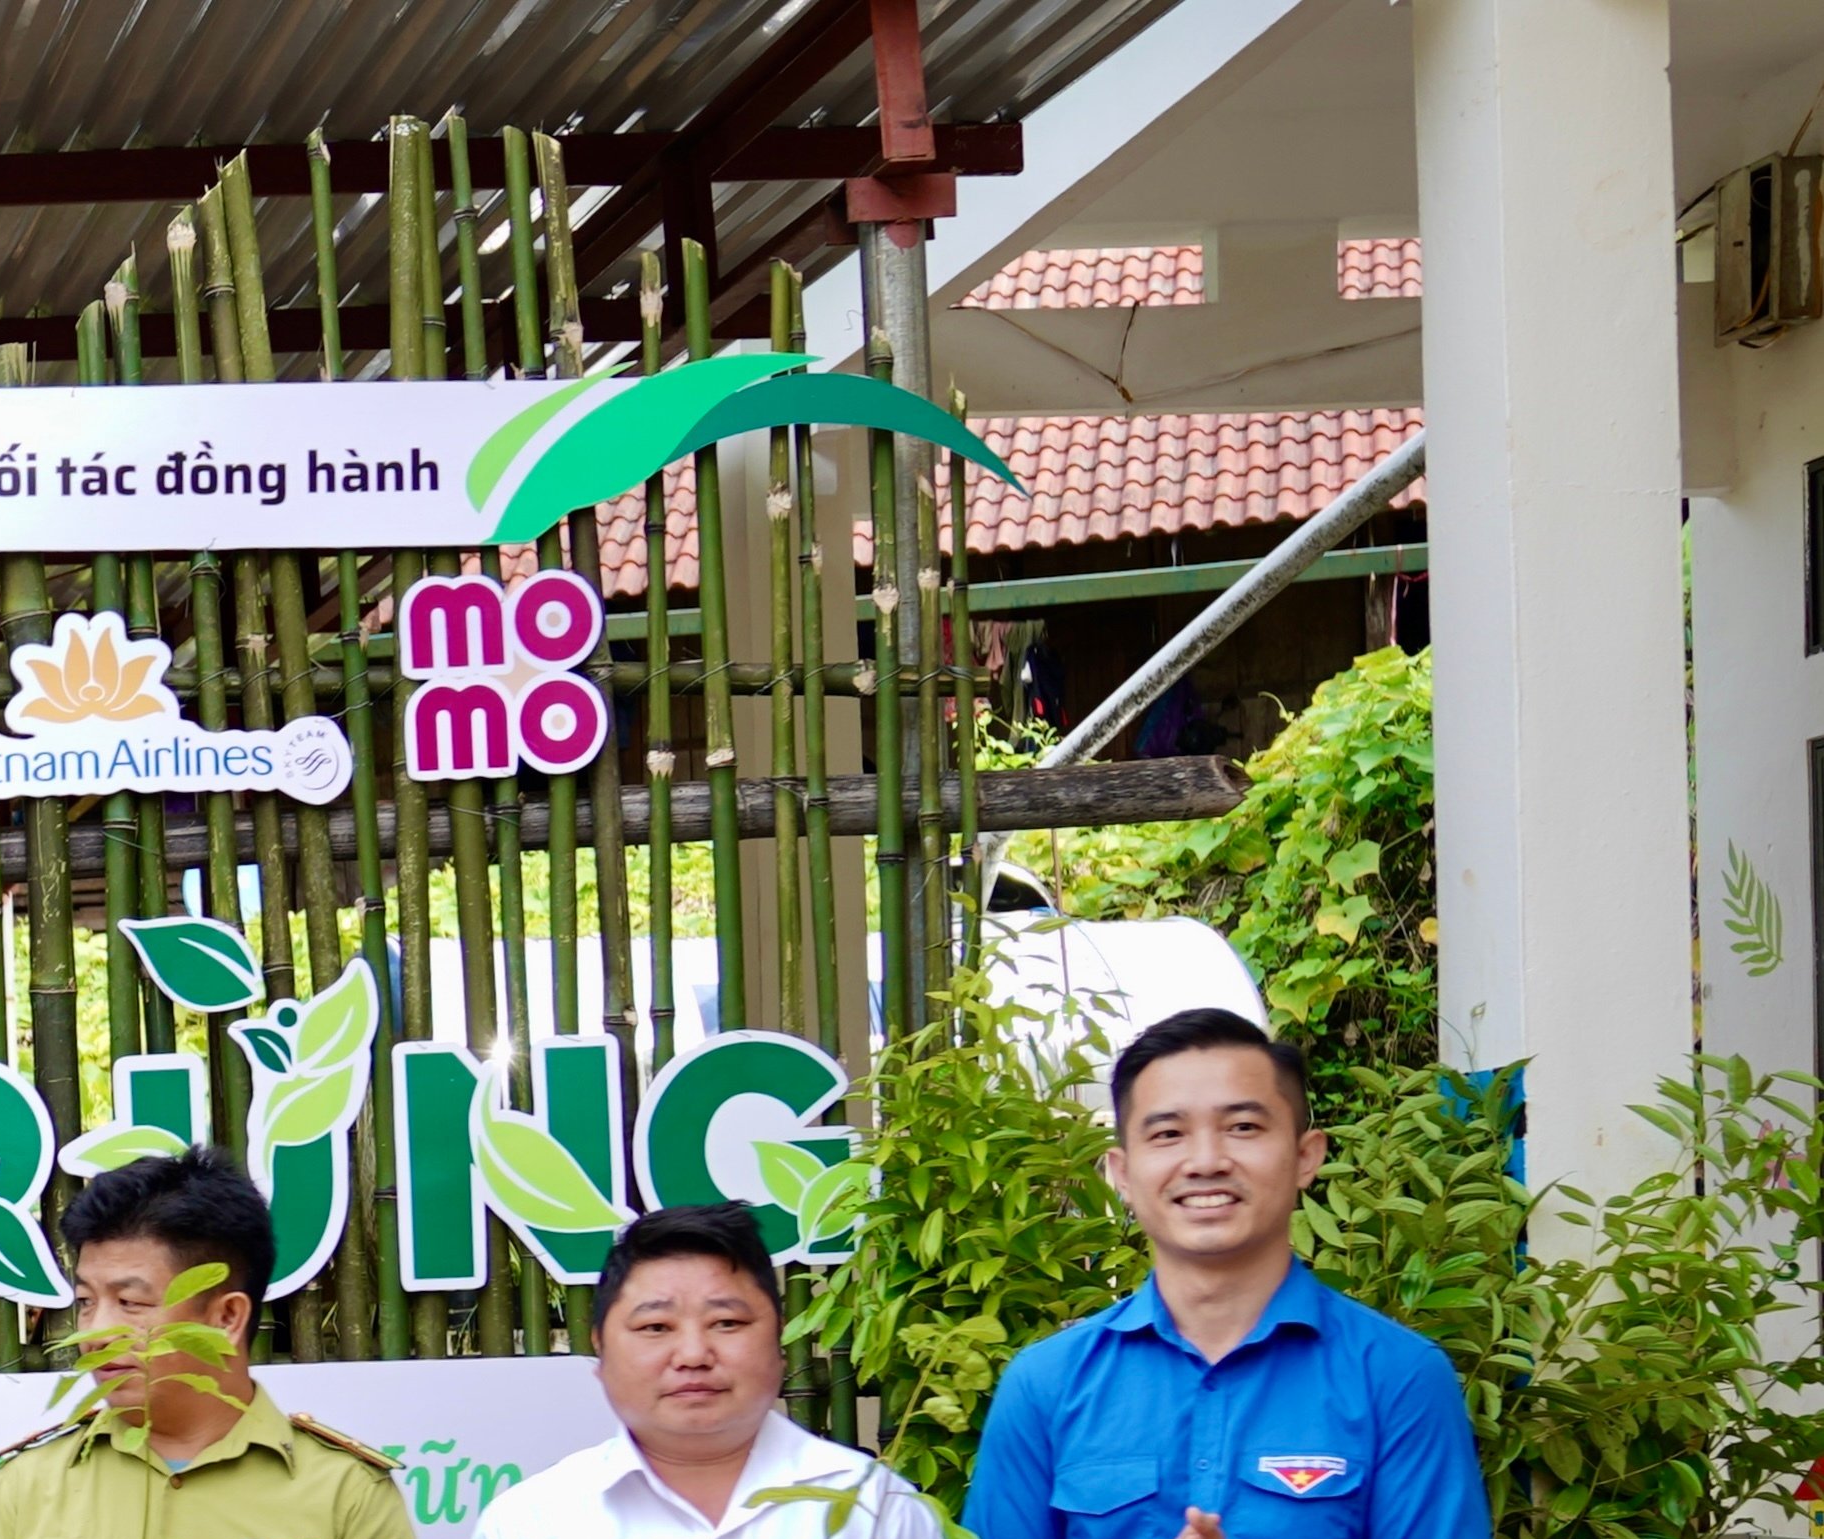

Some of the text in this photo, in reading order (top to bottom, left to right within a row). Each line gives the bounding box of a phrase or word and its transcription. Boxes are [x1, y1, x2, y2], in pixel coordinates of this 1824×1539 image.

[56, 452, 136, 496] tác
[156, 441, 287, 505] đồng
[307, 448, 440, 494] hành
[107, 735, 273, 779] Airlines
